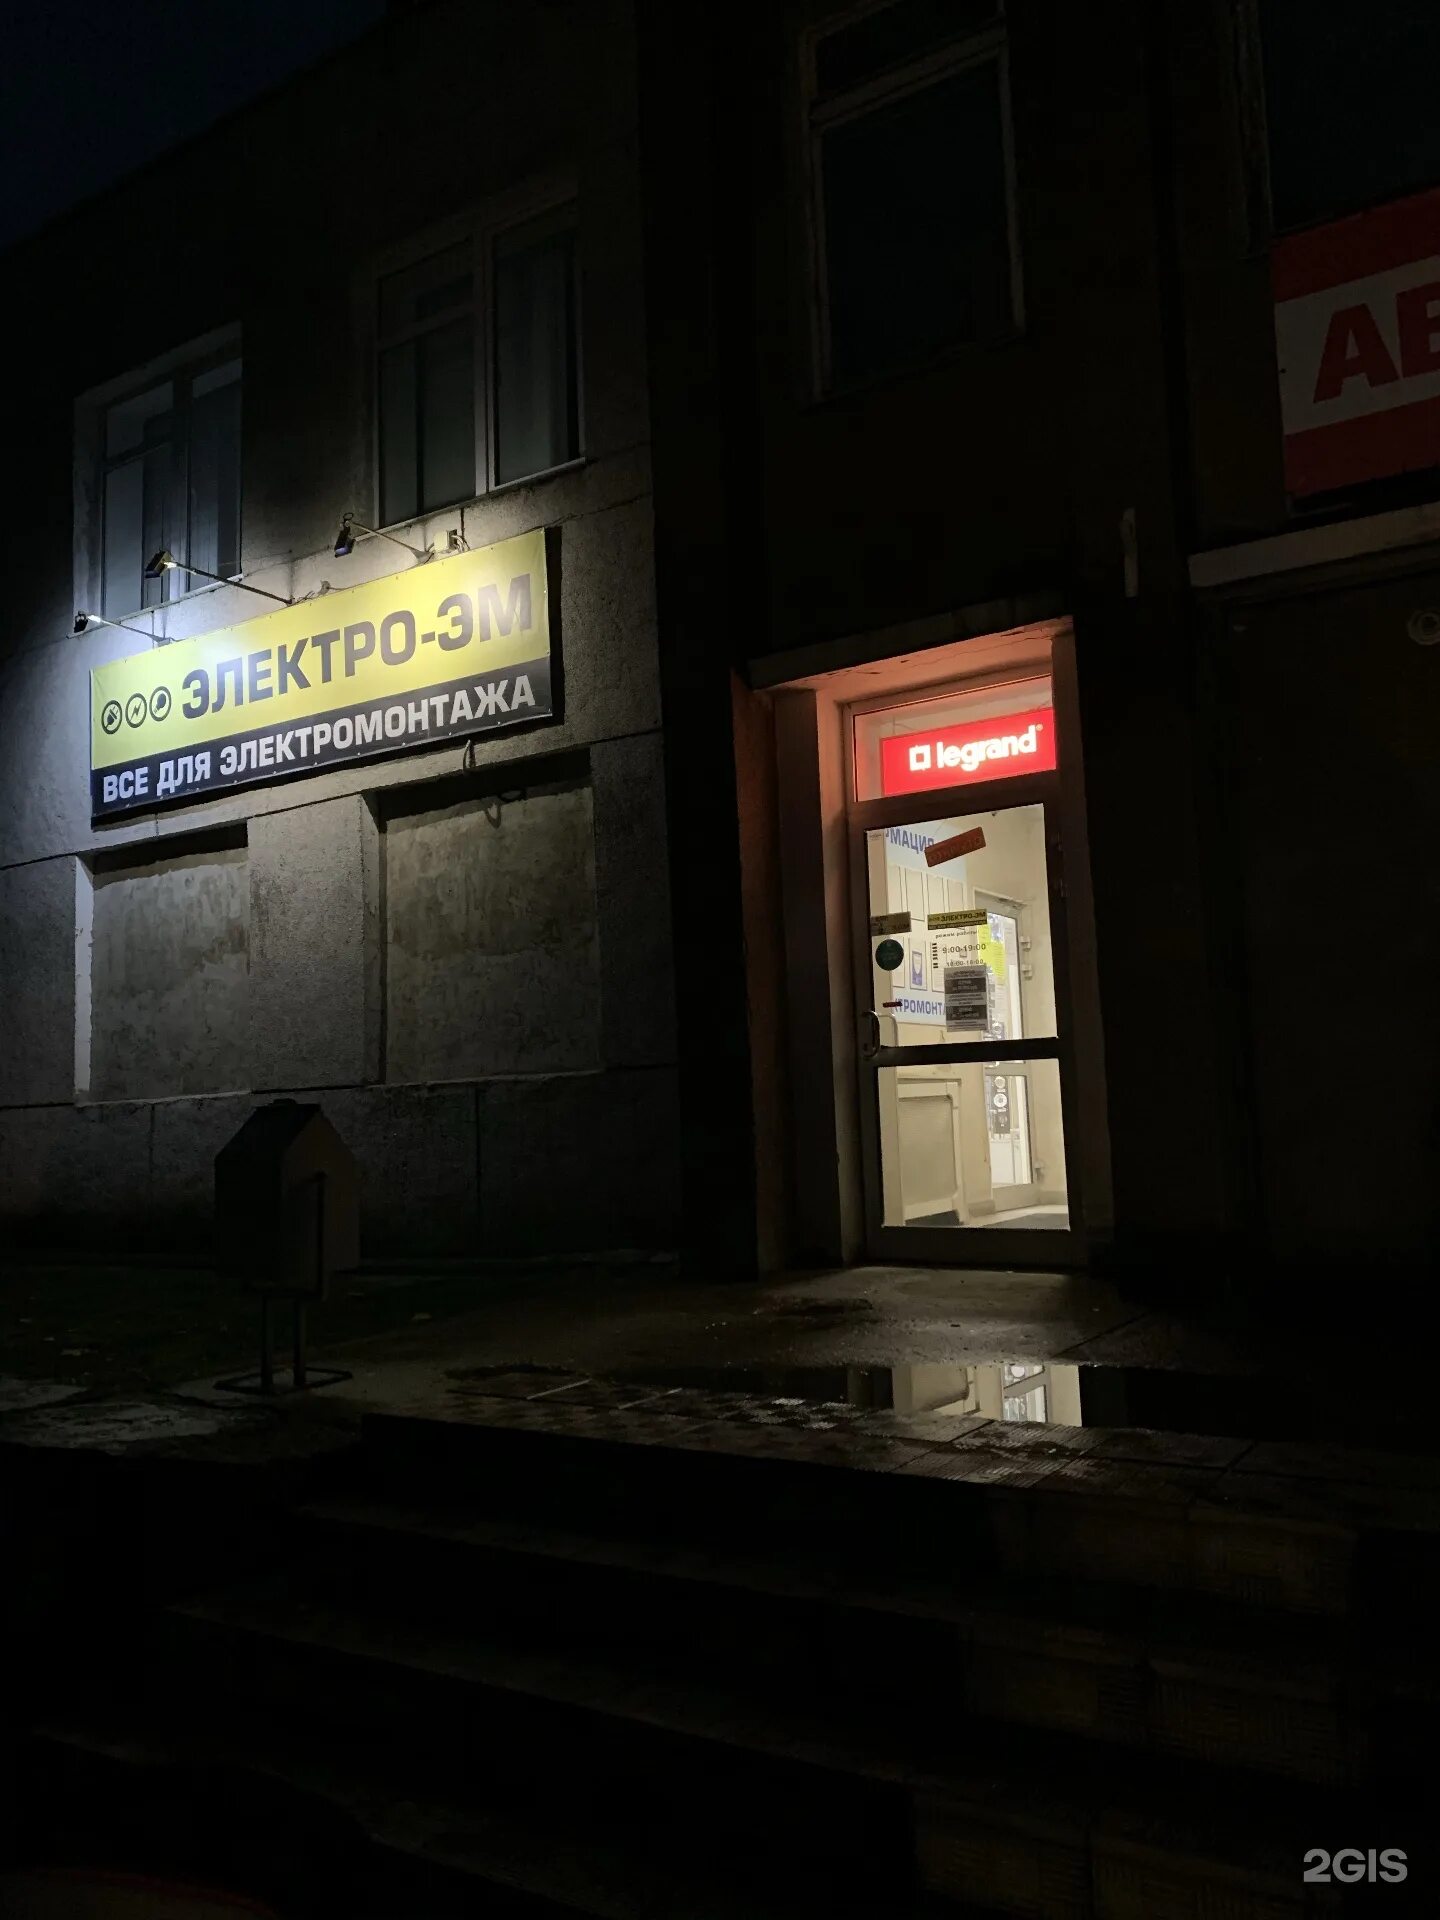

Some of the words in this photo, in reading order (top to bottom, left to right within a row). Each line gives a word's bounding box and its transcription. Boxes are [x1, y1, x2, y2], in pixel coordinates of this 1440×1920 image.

[182, 573, 533, 720] ЭЛЕКТРО-ЭМ
[103, 766, 148, 804] ВСЕ
[156, 752, 211, 797] ДЛЯ
[219, 674, 536, 776] ЭЛЕКТРОМОНТАЖА
[937, 724, 1038, 772] legrand
[942, 943, 986, 954] 9:00-19:00
